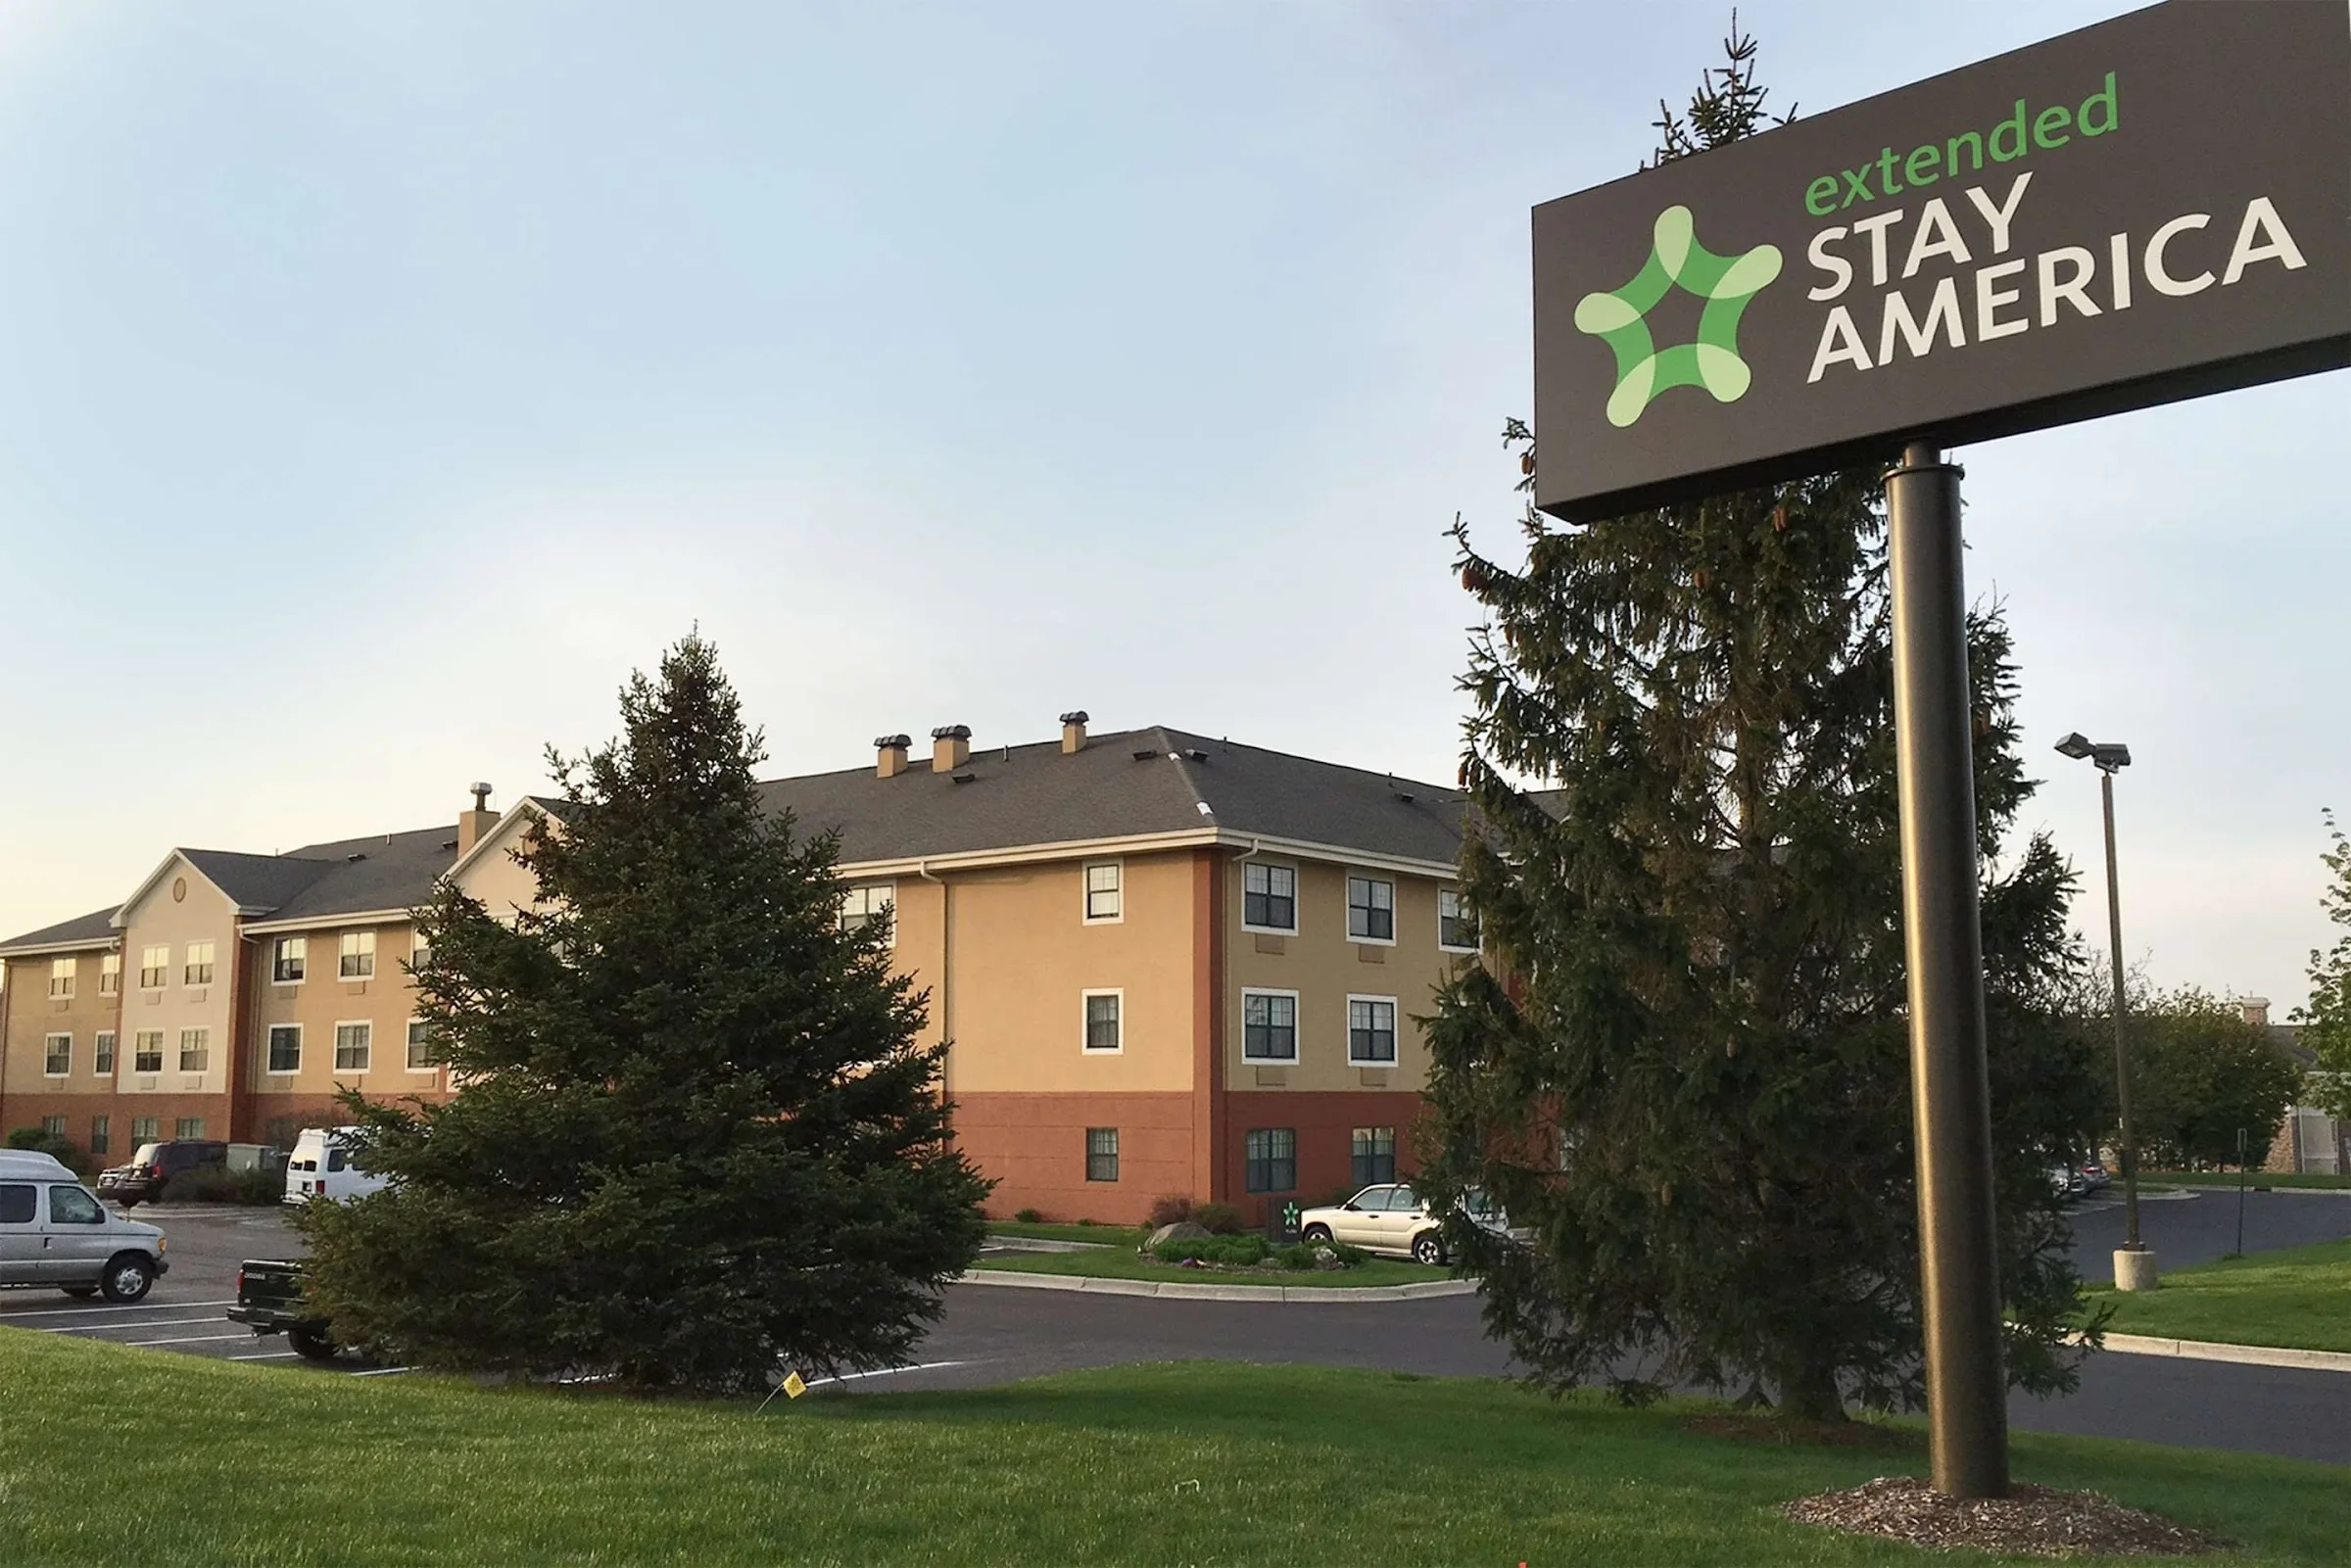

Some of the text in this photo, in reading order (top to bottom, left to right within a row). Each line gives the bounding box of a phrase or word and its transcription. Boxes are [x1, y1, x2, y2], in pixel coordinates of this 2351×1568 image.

[1805, 71, 2118, 216] extended
[1807, 170, 2034, 302] STAY
[1807, 197, 2308, 384] AMERICA
